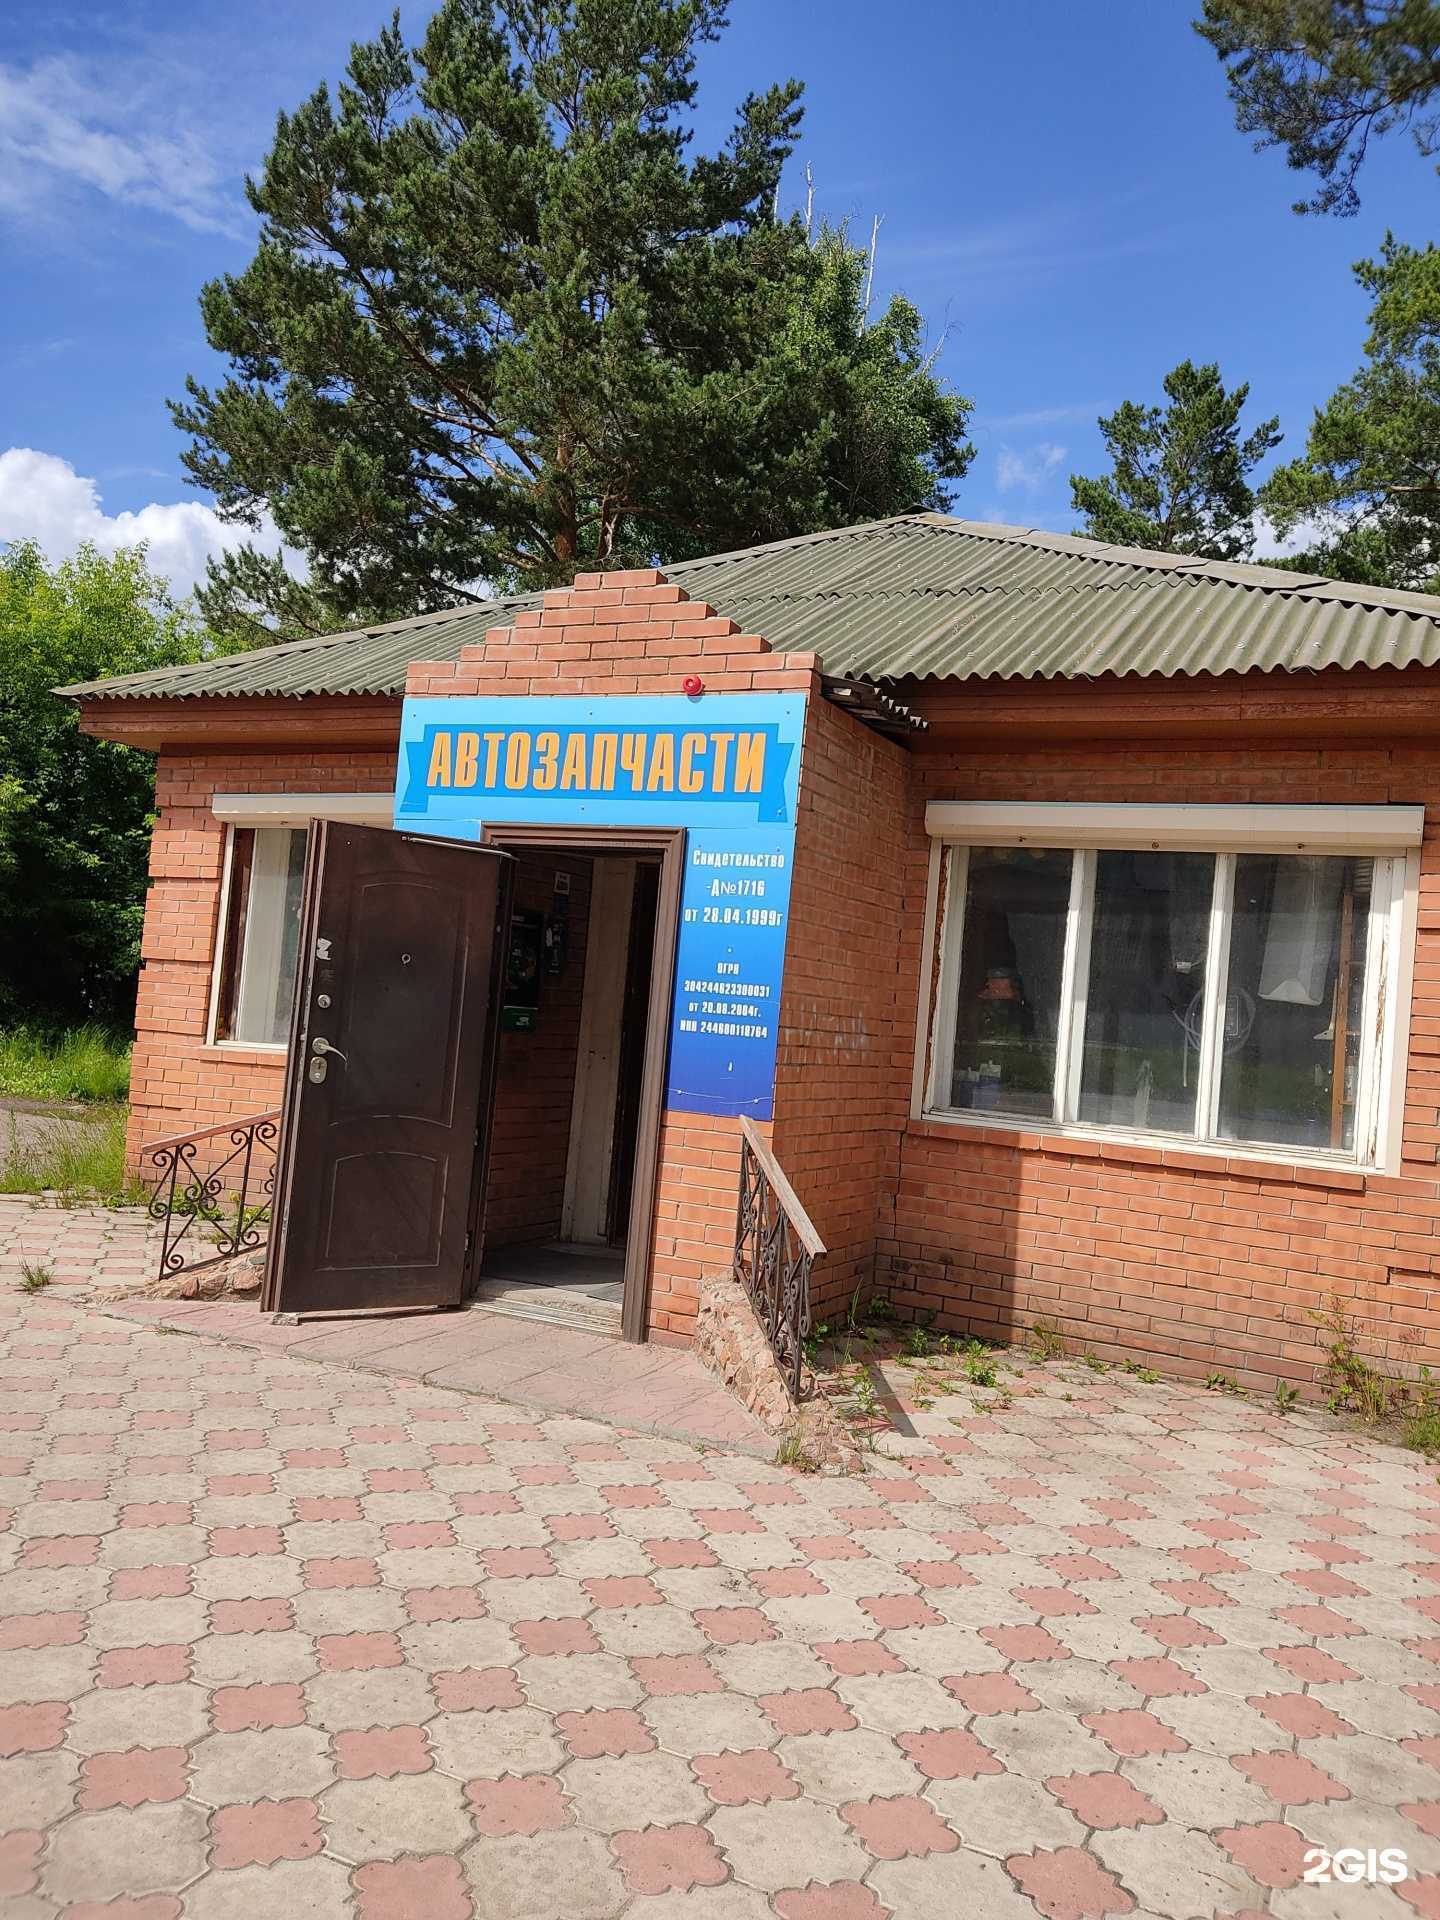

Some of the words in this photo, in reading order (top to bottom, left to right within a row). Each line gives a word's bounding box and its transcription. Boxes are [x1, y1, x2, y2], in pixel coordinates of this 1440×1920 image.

[427, 732, 767, 793] АВТОЗАПЧАСТИ
[693, 850, 785, 868] Свидетельство
[685, 909, 698, 922] от
[703, 907, 783, 926] 28.04.1999г
[717, 962, 740, 975] ОГРН
[684, 980, 770, 997] 304244623300031
[688, 1002, 699, 1012] от
[680, 1019, 697, 1032] ИНН
[701, 1021, 768, 1038] 244600118764
